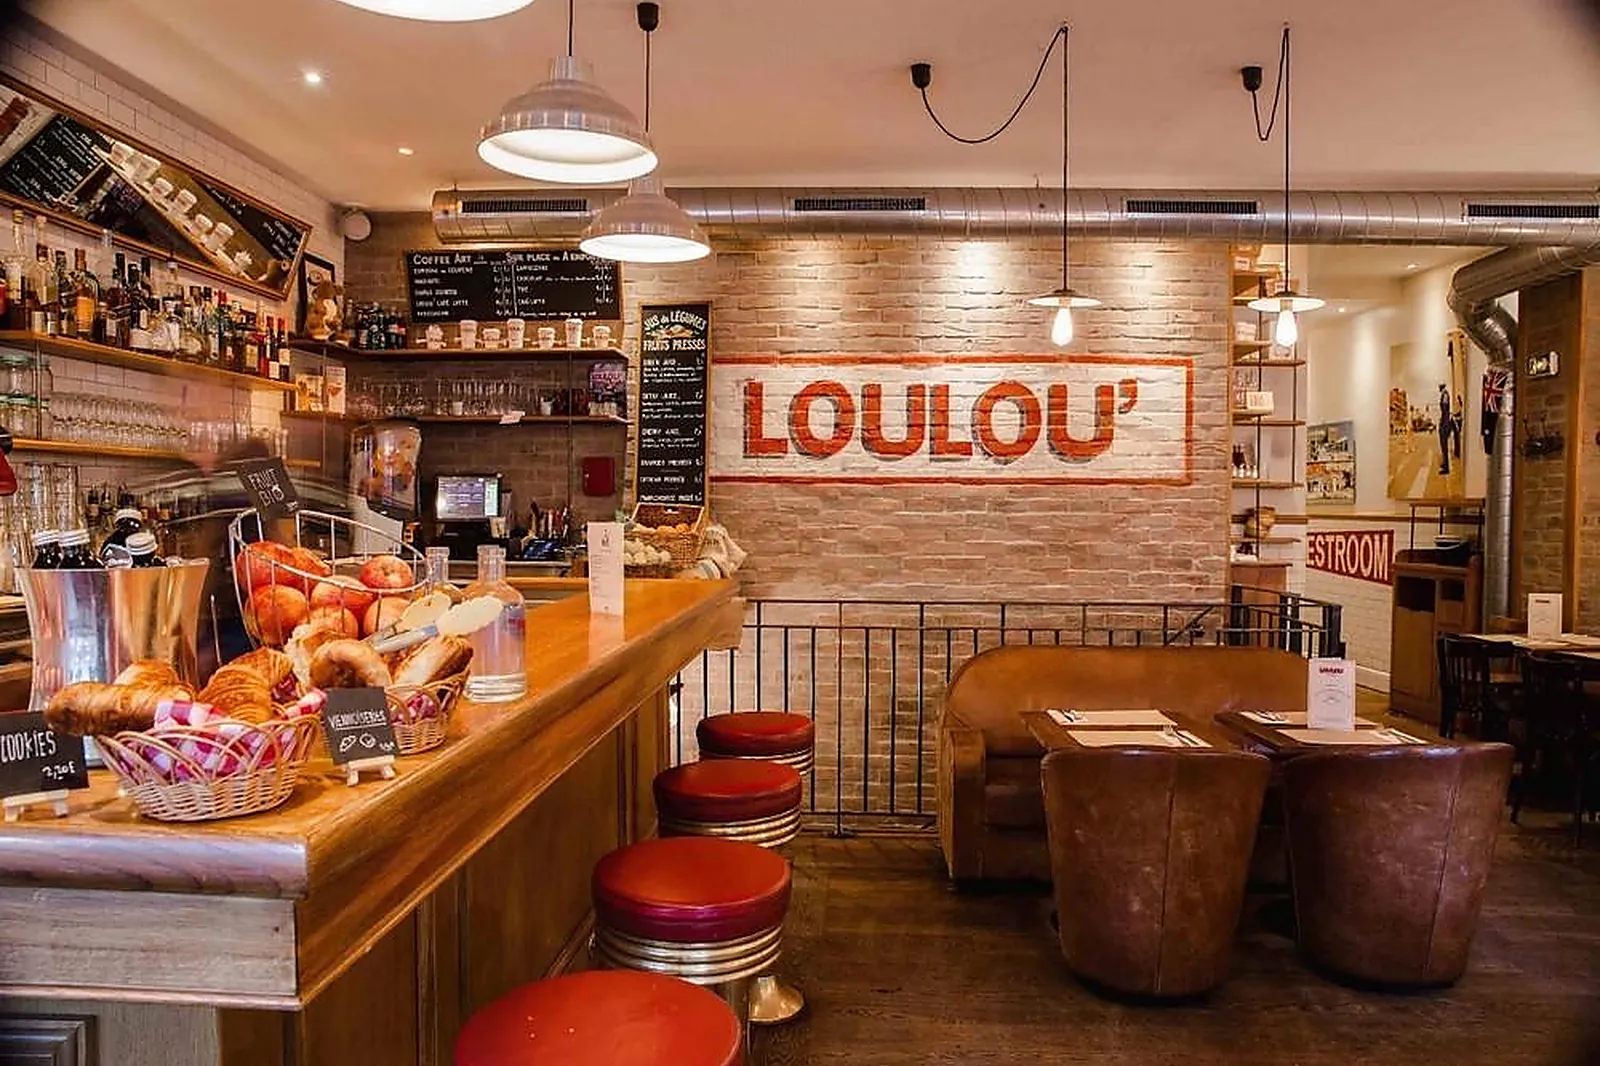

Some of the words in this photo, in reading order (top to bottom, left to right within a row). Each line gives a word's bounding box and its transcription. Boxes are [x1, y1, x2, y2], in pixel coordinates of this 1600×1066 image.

[643, 340, 670, 351] FRUITS
[743, 379, 1138, 464] LOULOU'
[248, 468, 278, 490] FRUIT
[259, 485, 285, 507] BIO
[1307, 533, 1388, 580] ESTROOM
